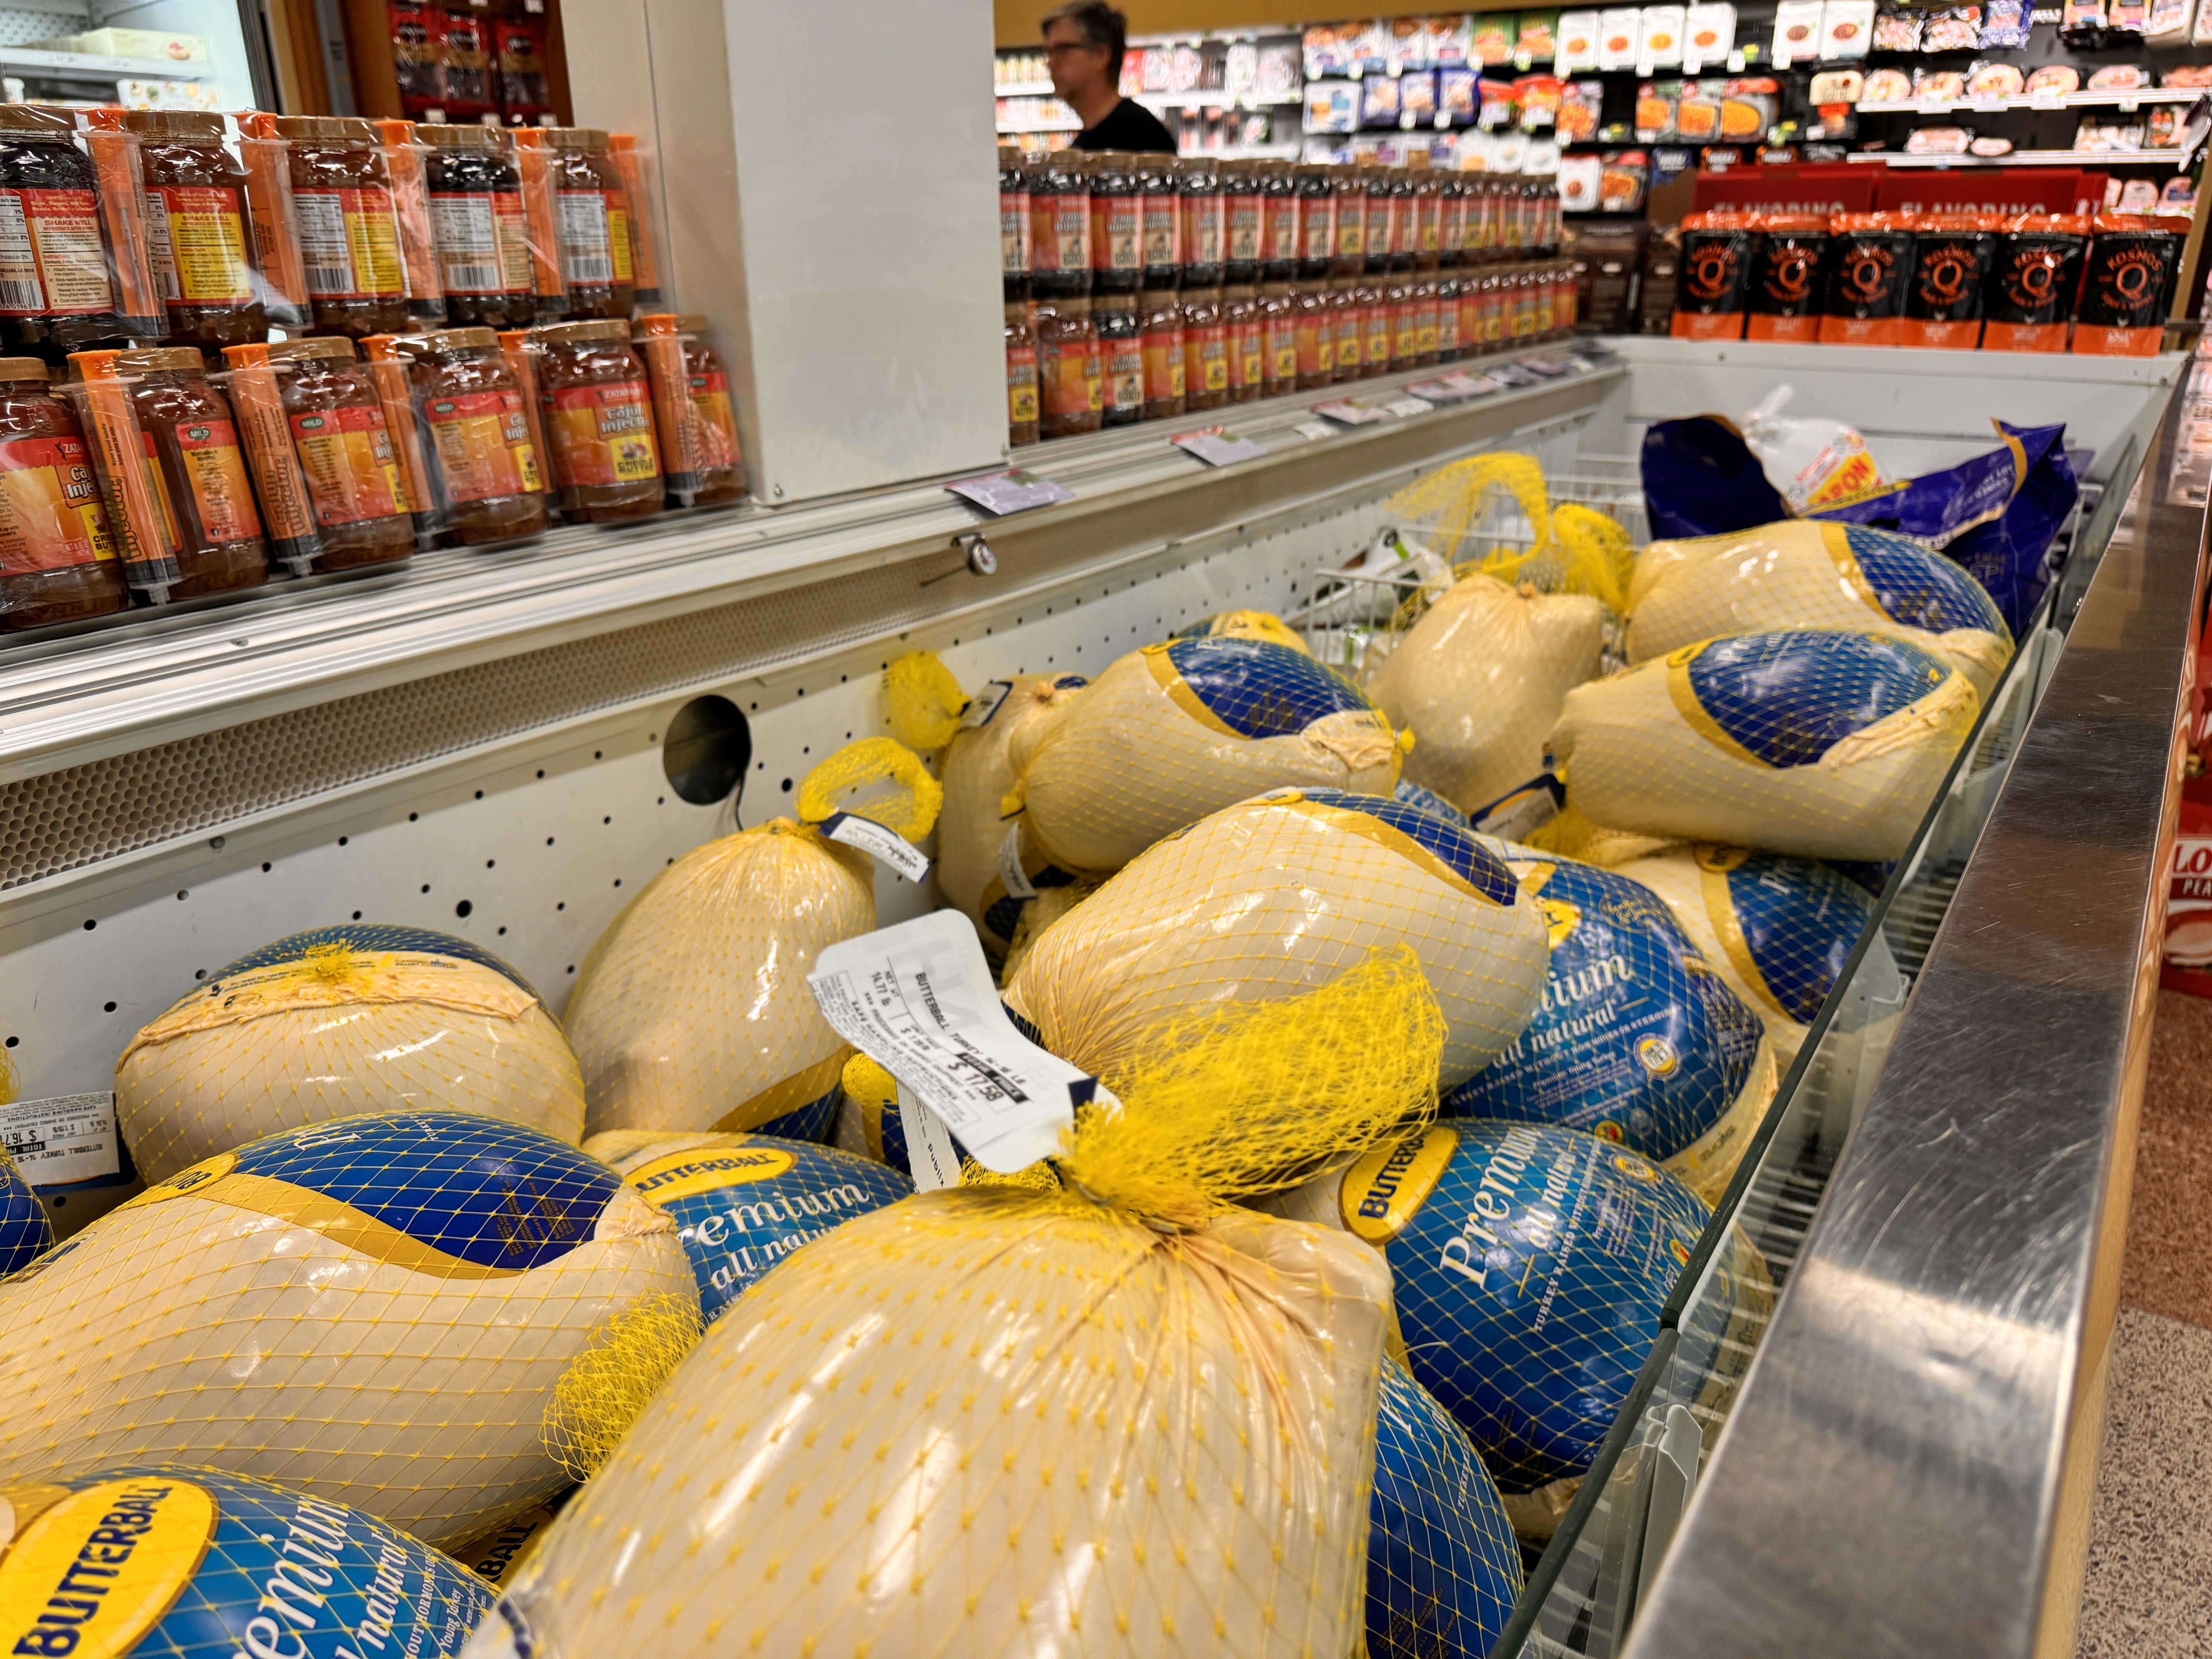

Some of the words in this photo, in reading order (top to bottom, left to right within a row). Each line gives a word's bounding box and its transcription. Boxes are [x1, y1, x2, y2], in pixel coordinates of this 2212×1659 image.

[2106, 246, 2163, 271] KOSMOS
[1852, 258, 1881, 294] Q
[1932, 259, 1963, 295] Q
[2021, 261, 2053, 298] Q
[2116, 262, 2147, 300] Q
[301, 419, 323, 427] MILD
[607, 406, 642, 420] Cajun
[64, 444, 82, 453] ZATA
[189, 430, 209, 438] MILD
[66, 483, 97, 499] Inje
[2183, 879, 2212, 896] PEA
[871, 971, 887, 993] 14.77
[884, 971, 895, 984] NET
[852, 1000, 867, 1022] SAFE
[916, 972, 950, 1030] BUTTERBALL
[950, 1033, 984, 1054] TURKEY
[1531, 1002, 1617, 1051] natural
[966, 1073, 1004, 1101] 17.58
[8, 1112, 51, 1121] INSTRUCTIONS
[22, 1143, 43, 1152] TOTAL
[29, 1130, 36, 1142] $
[68, 1144, 103, 1154] BUTTERBALL
[18, 1154, 36, 1163] 14-16
[41, 1149, 64, 1159] TURKEY
[928, 1143, 944, 1187] Publix
[635, 1153, 778, 1192] UTTERBALL
[1358, 1128, 1428, 1218] BUTTERB
[677, 1183, 869, 1247] remium
[1439, 1127, 1540, 1289] Premium
[1526, 1206, 1557, 1249] all
[711, 1252, 758, 1290] all
[1534, 1276, 1559, 1332] TURKEY
[1554, 1232, 1576, 1276] RAISED
[475, 1522, 538, 1582] BALL
[12, 1486, 174, 1658] BUTTERBALL
[357, 1532, 407, 1651] natural
[416, 1566, 436, 1622] HORMONES
[447, 1588, 464, 1616] Turkey
[440, 1617, 460, 1649] Young
